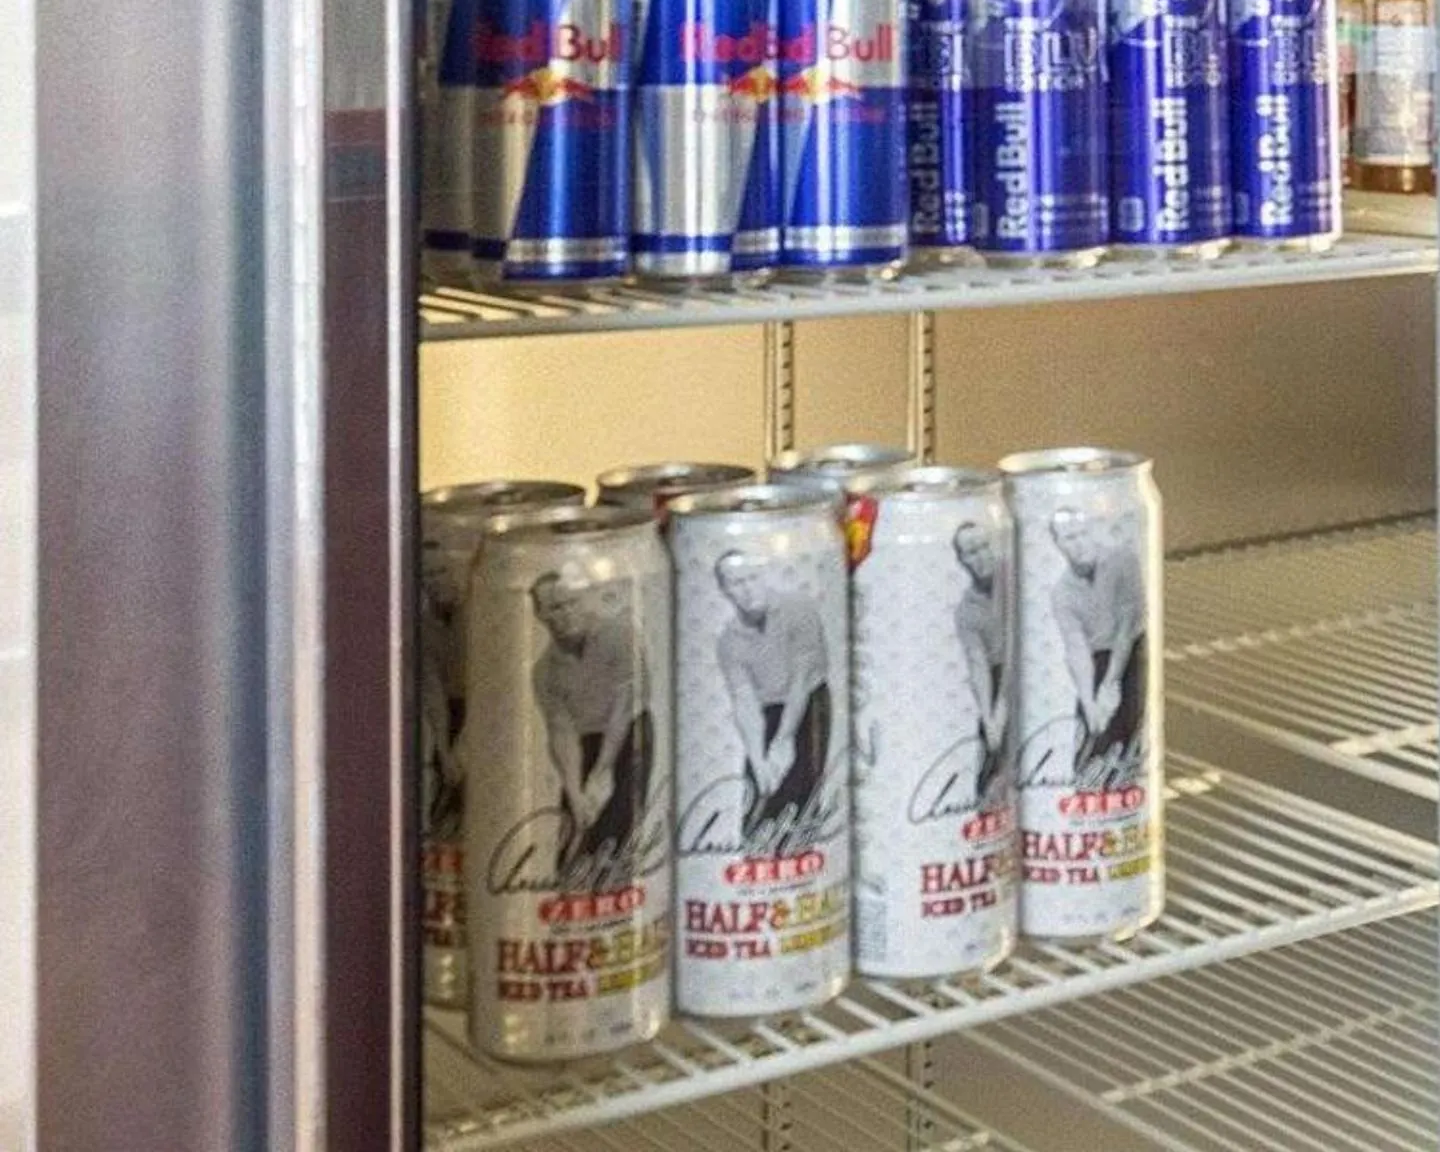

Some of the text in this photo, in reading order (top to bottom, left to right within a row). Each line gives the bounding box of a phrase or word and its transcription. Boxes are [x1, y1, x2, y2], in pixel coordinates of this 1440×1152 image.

[557, 23, 622, 63] Bul
[826, 22, 894, 63] Bull
[994, 102, 1029, 238] Red Bull
[1150, 97, 1189, 232] Red Bull
[1256, 94, 1293, 226] Red Bull
[920, 853, 998, 894] HALF
[684, 899, 767, 934] HALF
[498, 937, 589, 974] HALF
[684, 938, 729, 960] ICED
